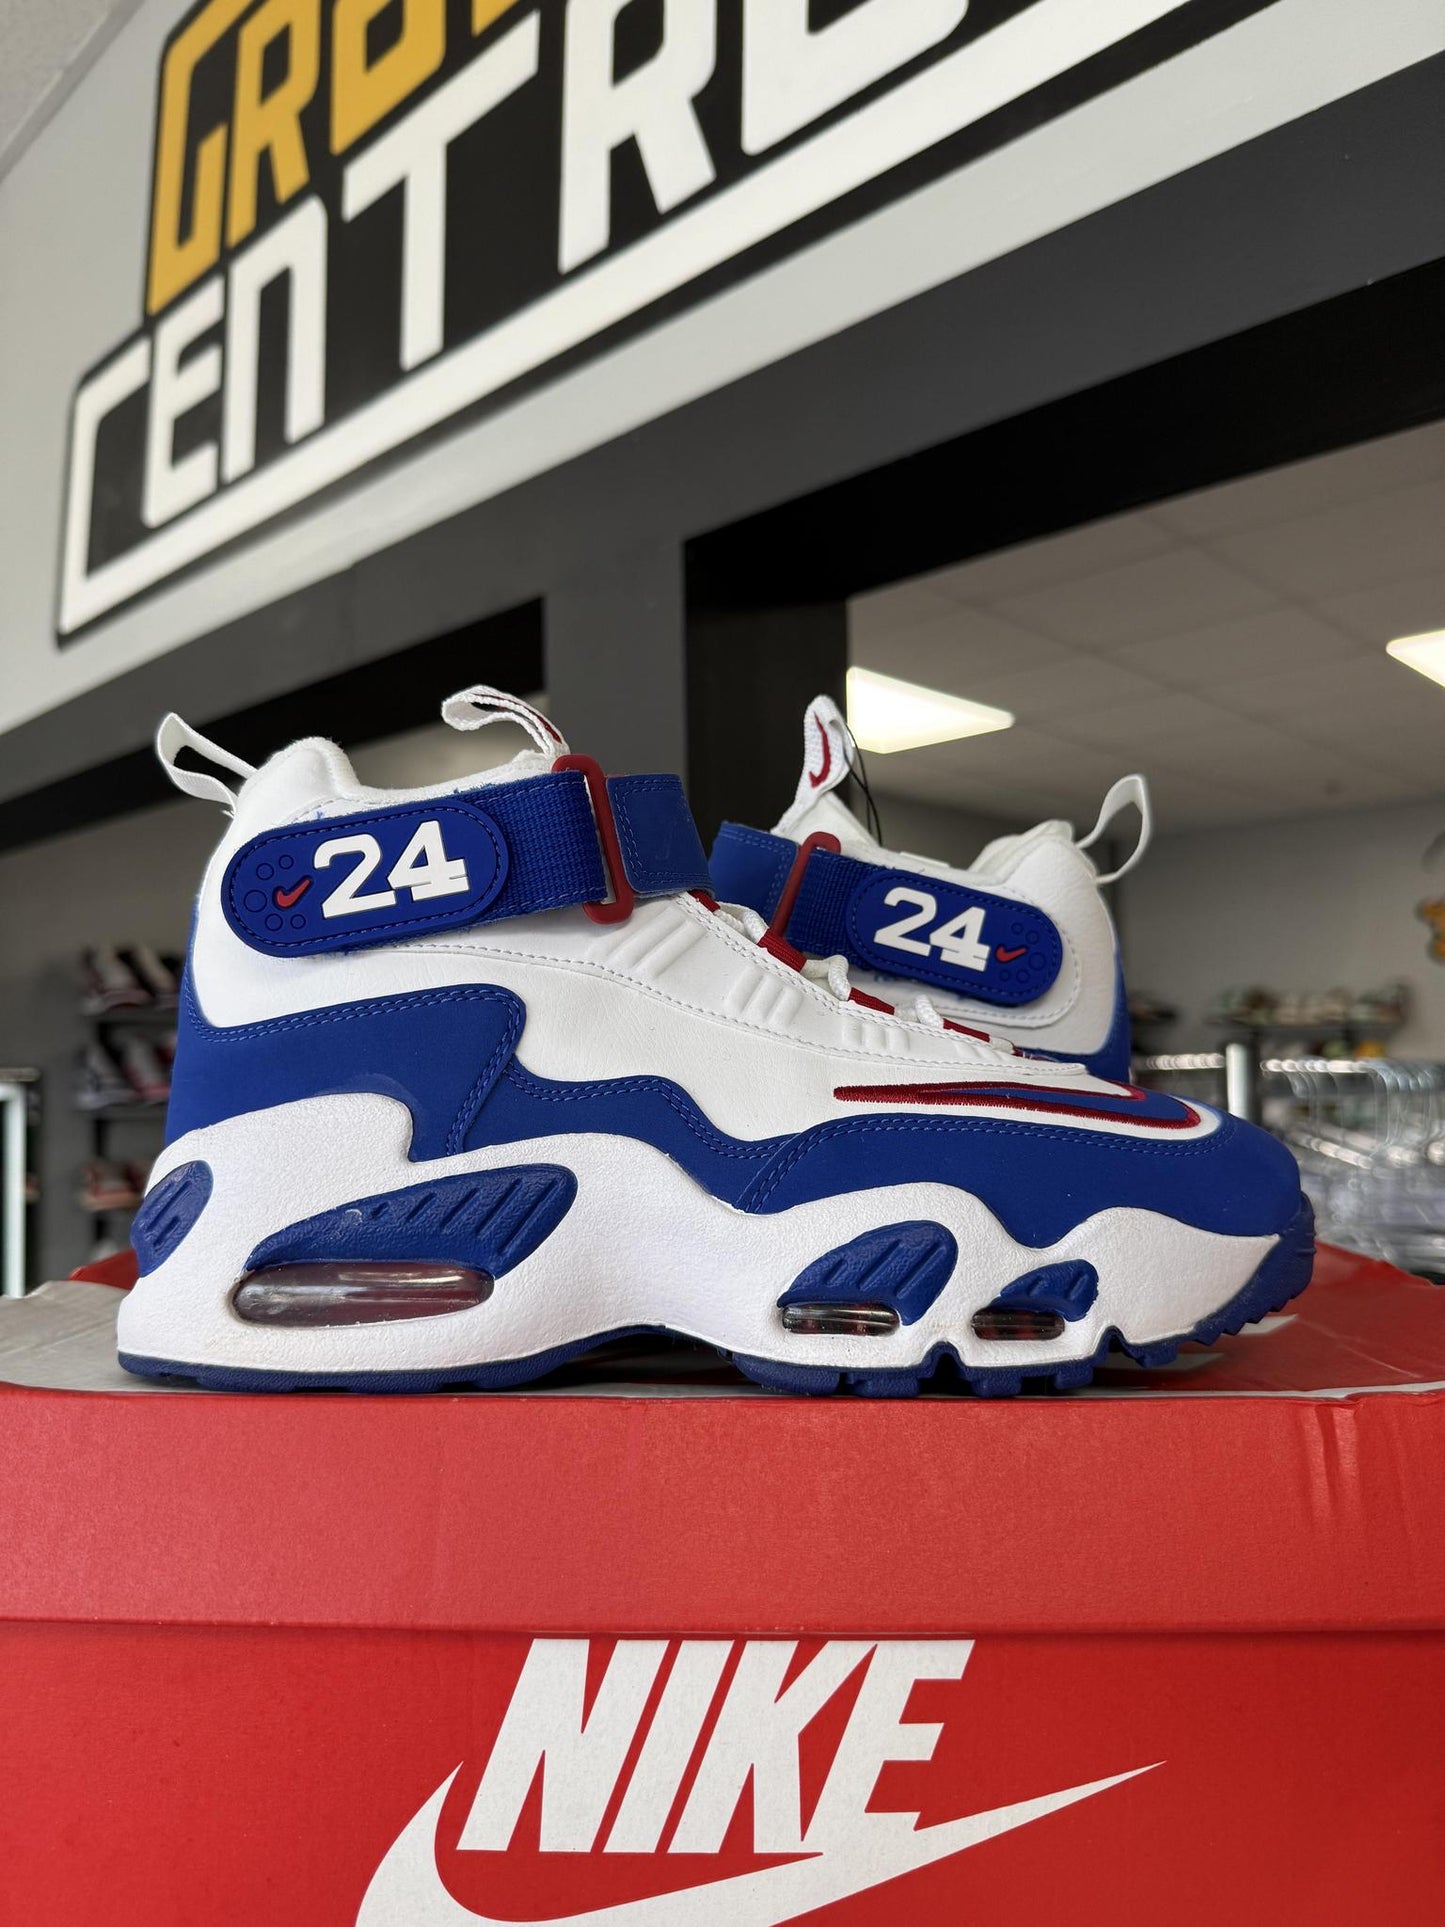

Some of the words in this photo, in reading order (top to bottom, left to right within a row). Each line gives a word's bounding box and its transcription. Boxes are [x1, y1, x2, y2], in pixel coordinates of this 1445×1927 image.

[148, 0, 517, 315] GRO
[59, 0, 968, 634] CENTR
[313, 820, 470, 919] 24
[873, 886, 991, 972] 24
[456, 1638, 976, 1854] NIKE
